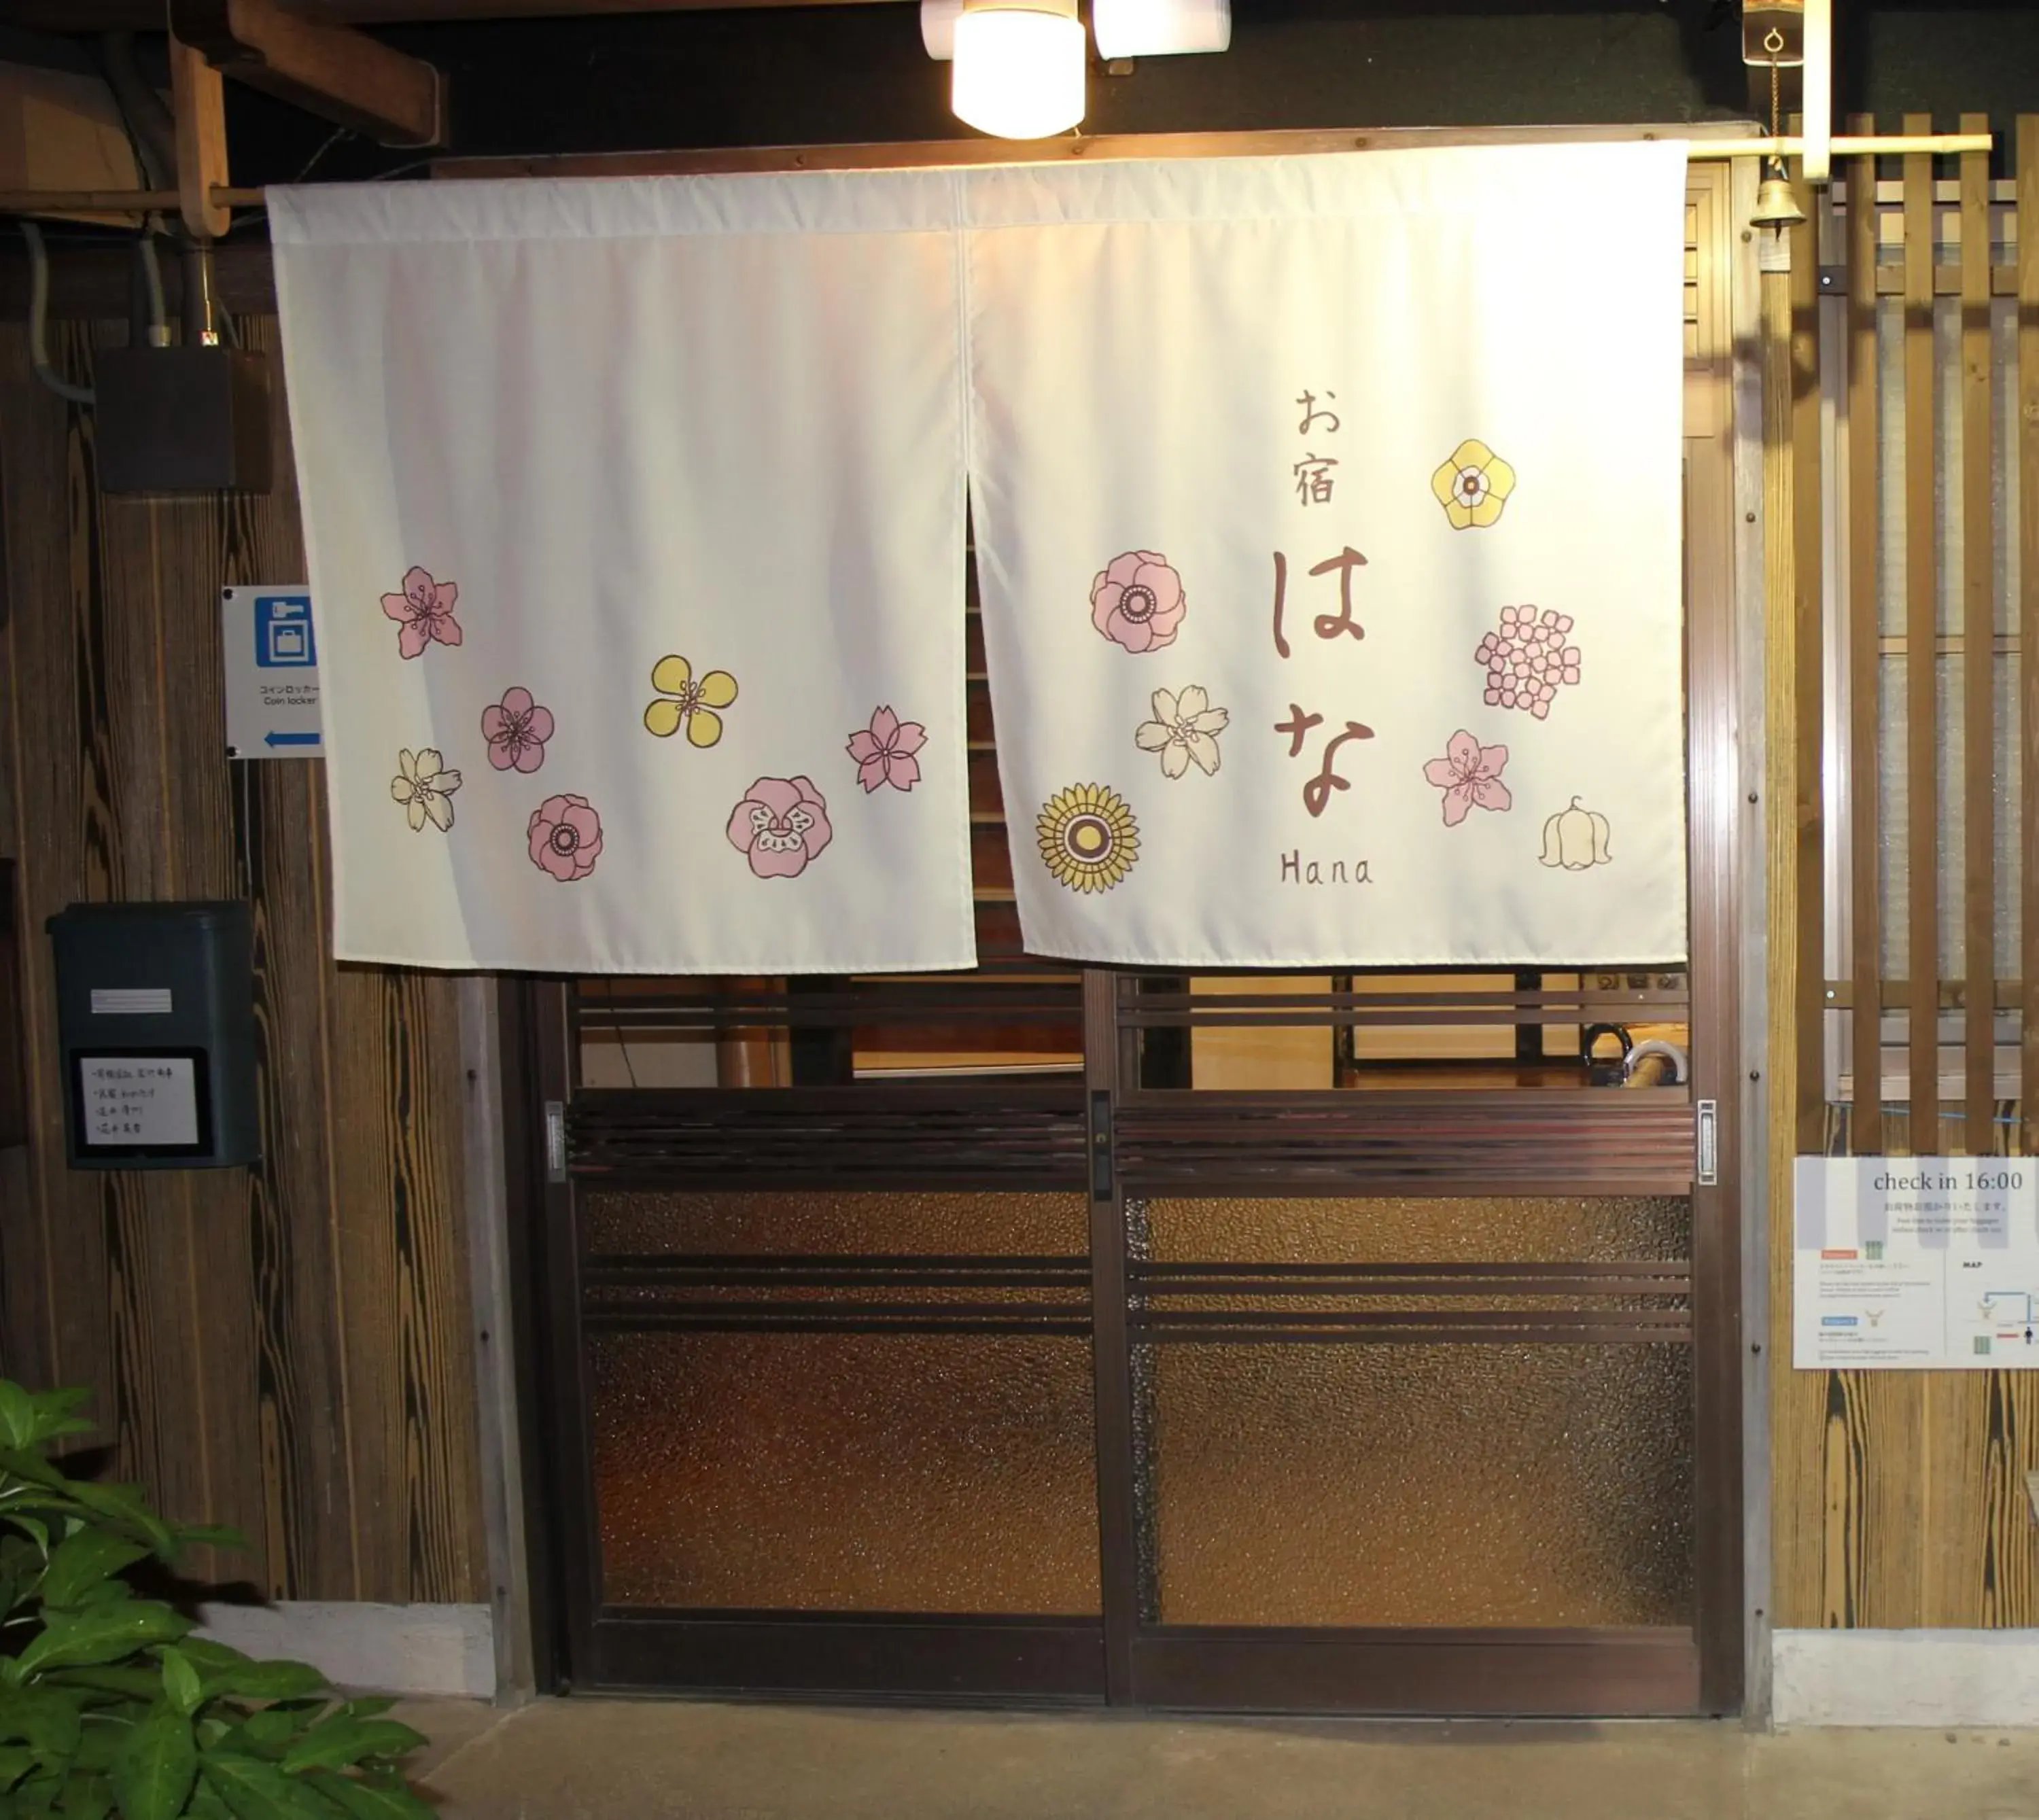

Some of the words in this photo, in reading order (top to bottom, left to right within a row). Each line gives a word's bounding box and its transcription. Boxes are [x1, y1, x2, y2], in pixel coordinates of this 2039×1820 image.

[1293, 389, 1340, 506] お宿
[260, 685, 320, 694] コインロッカー
[1273, 546, 1375, 818] はな
[264, 696, 284, 705] Coin
[287, 695, 317, 705] locker
[1280, 850, 1373, 883] Hana
[1874, 1172, 1932, 1190] check
[1938, 1173, 1957, 1190] in
[1966, 1172, 2023, 1190] 16:00
